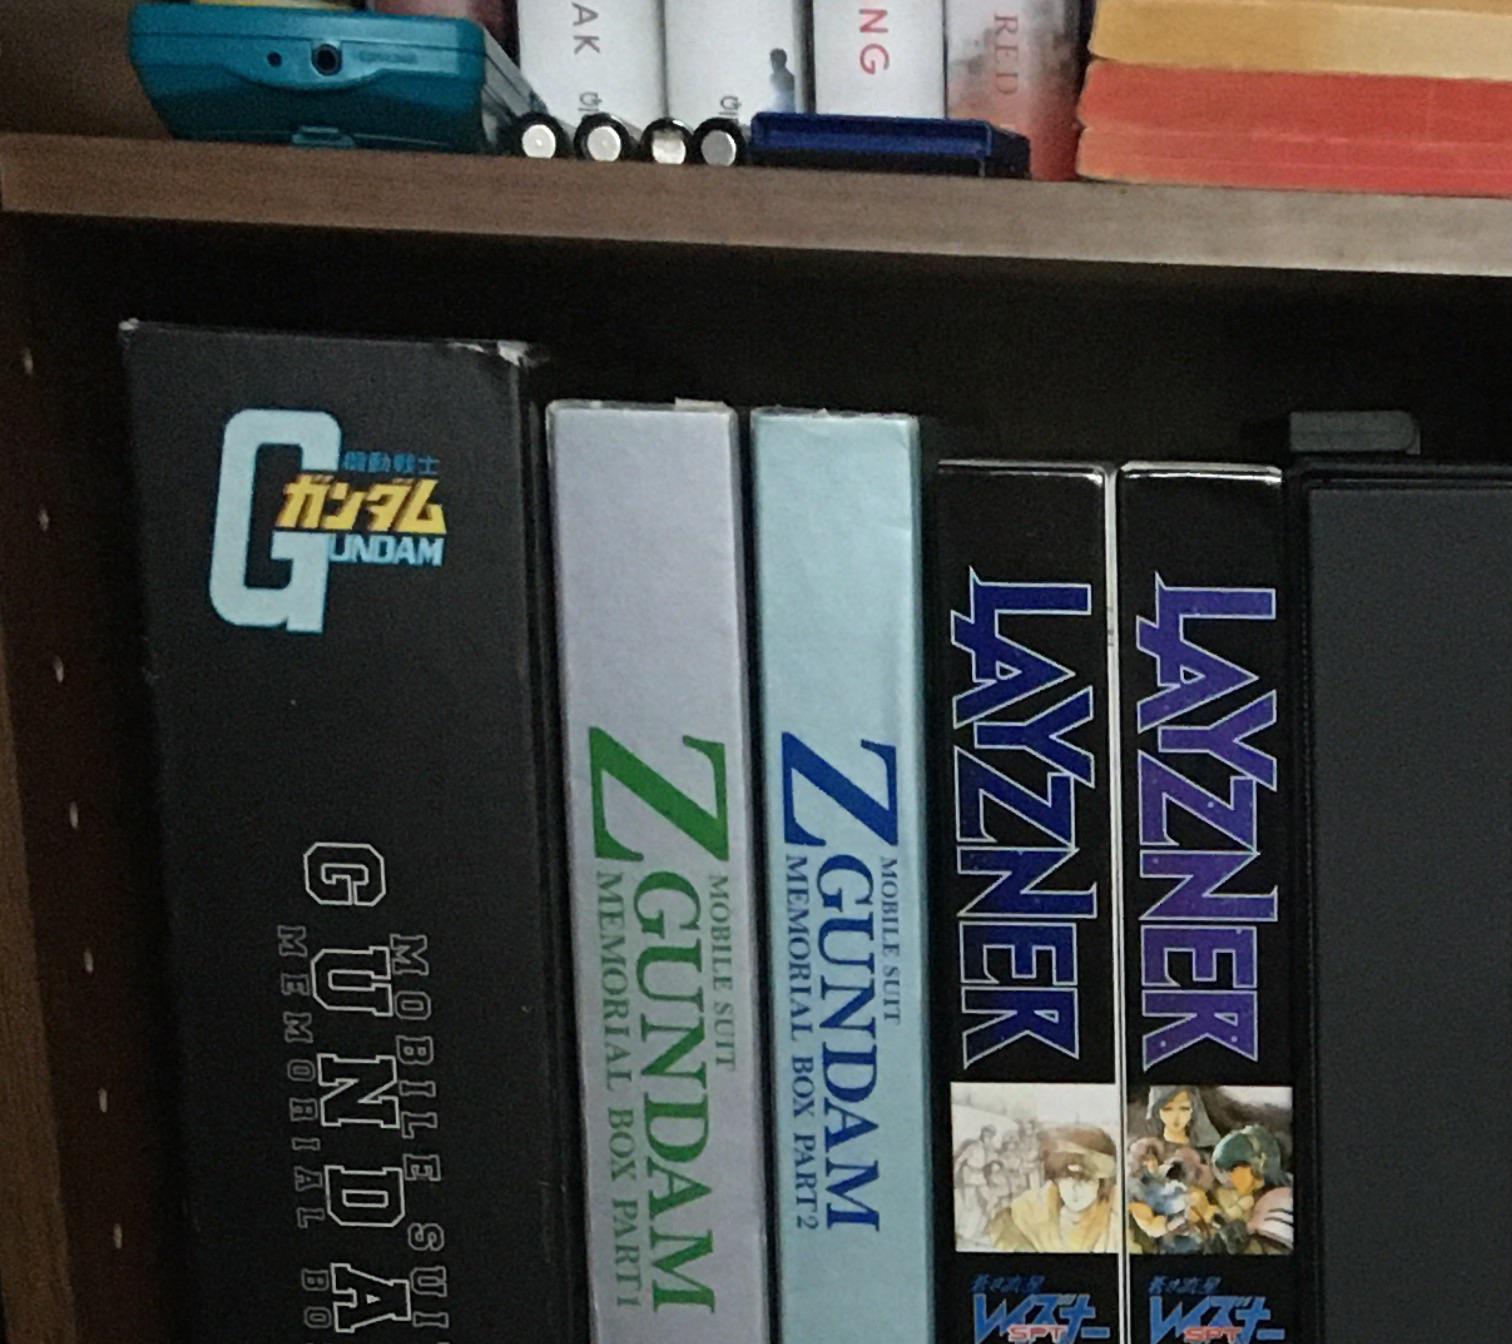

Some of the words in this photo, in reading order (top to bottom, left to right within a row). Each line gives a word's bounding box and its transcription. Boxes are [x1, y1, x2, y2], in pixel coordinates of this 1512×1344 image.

[275, 473, 447, 534] ガンダム
[588, 726, 729, 862] Z
[781, 731, 898, 848] Z
[950, 566, 1098, 1068] LAYZNER
[1136, 571, 1279, 1070] LAYZNER
[708, 875, 733, 991] MOBILE
[785, 855, 814, 1042] MEMORIAL
[880, 857, 900, 960] MOBILE
[597, 871, 632, 1092] MEMORIAL
[711, 1004, 736, 1071] SUIT
[815, 852, 881, 1233] GUNDAM
[883, 966, 901, 1025] SUIT
[278, 925, 325, 1229] MEMORIAL
[391, 933, 440, 1182] MOBILE
[633, 870, 716, 1314] GUNDAM
[791, 1054, 816, 1122] BOX
[607, 1108, 635, 1182] BOX
[1008, 1324, 1069, 1342] SPT
